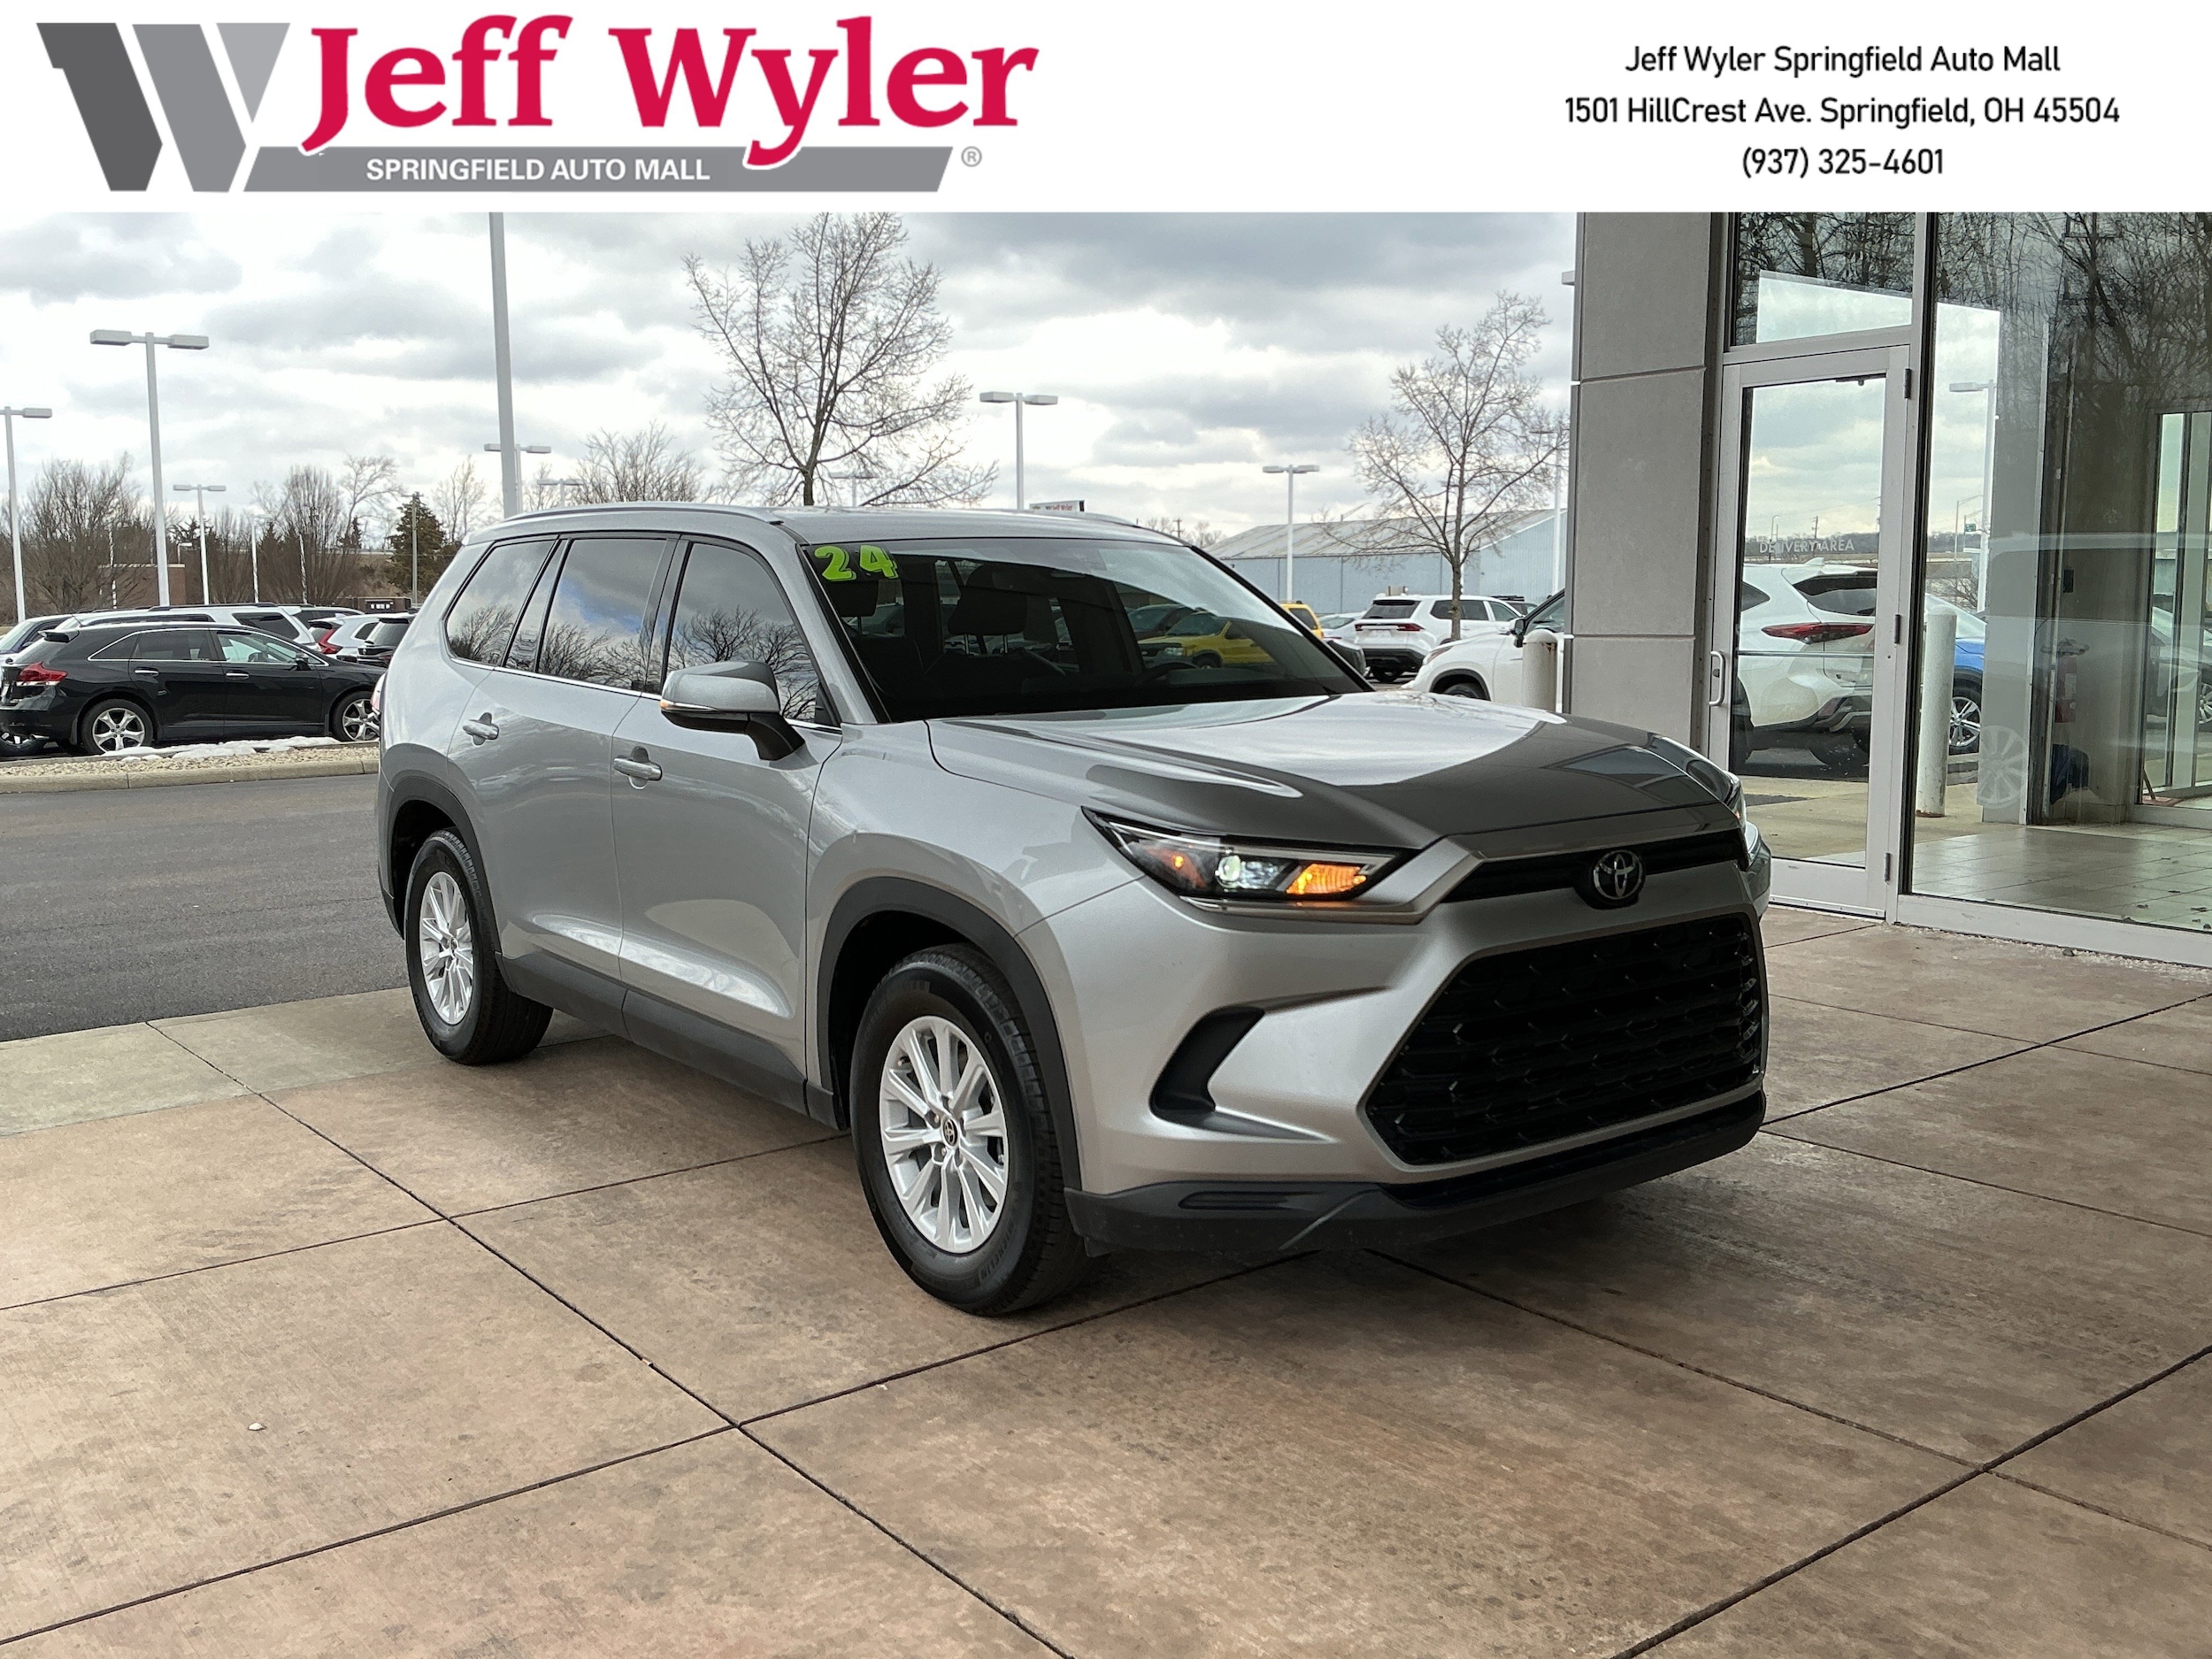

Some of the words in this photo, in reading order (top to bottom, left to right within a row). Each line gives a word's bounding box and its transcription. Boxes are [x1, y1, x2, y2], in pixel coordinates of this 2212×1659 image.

[1759, 540, 1817, 553] DEIVERY
[1820, 538, 1855, 551] AREA
[814, 545, 899, 581] 24
